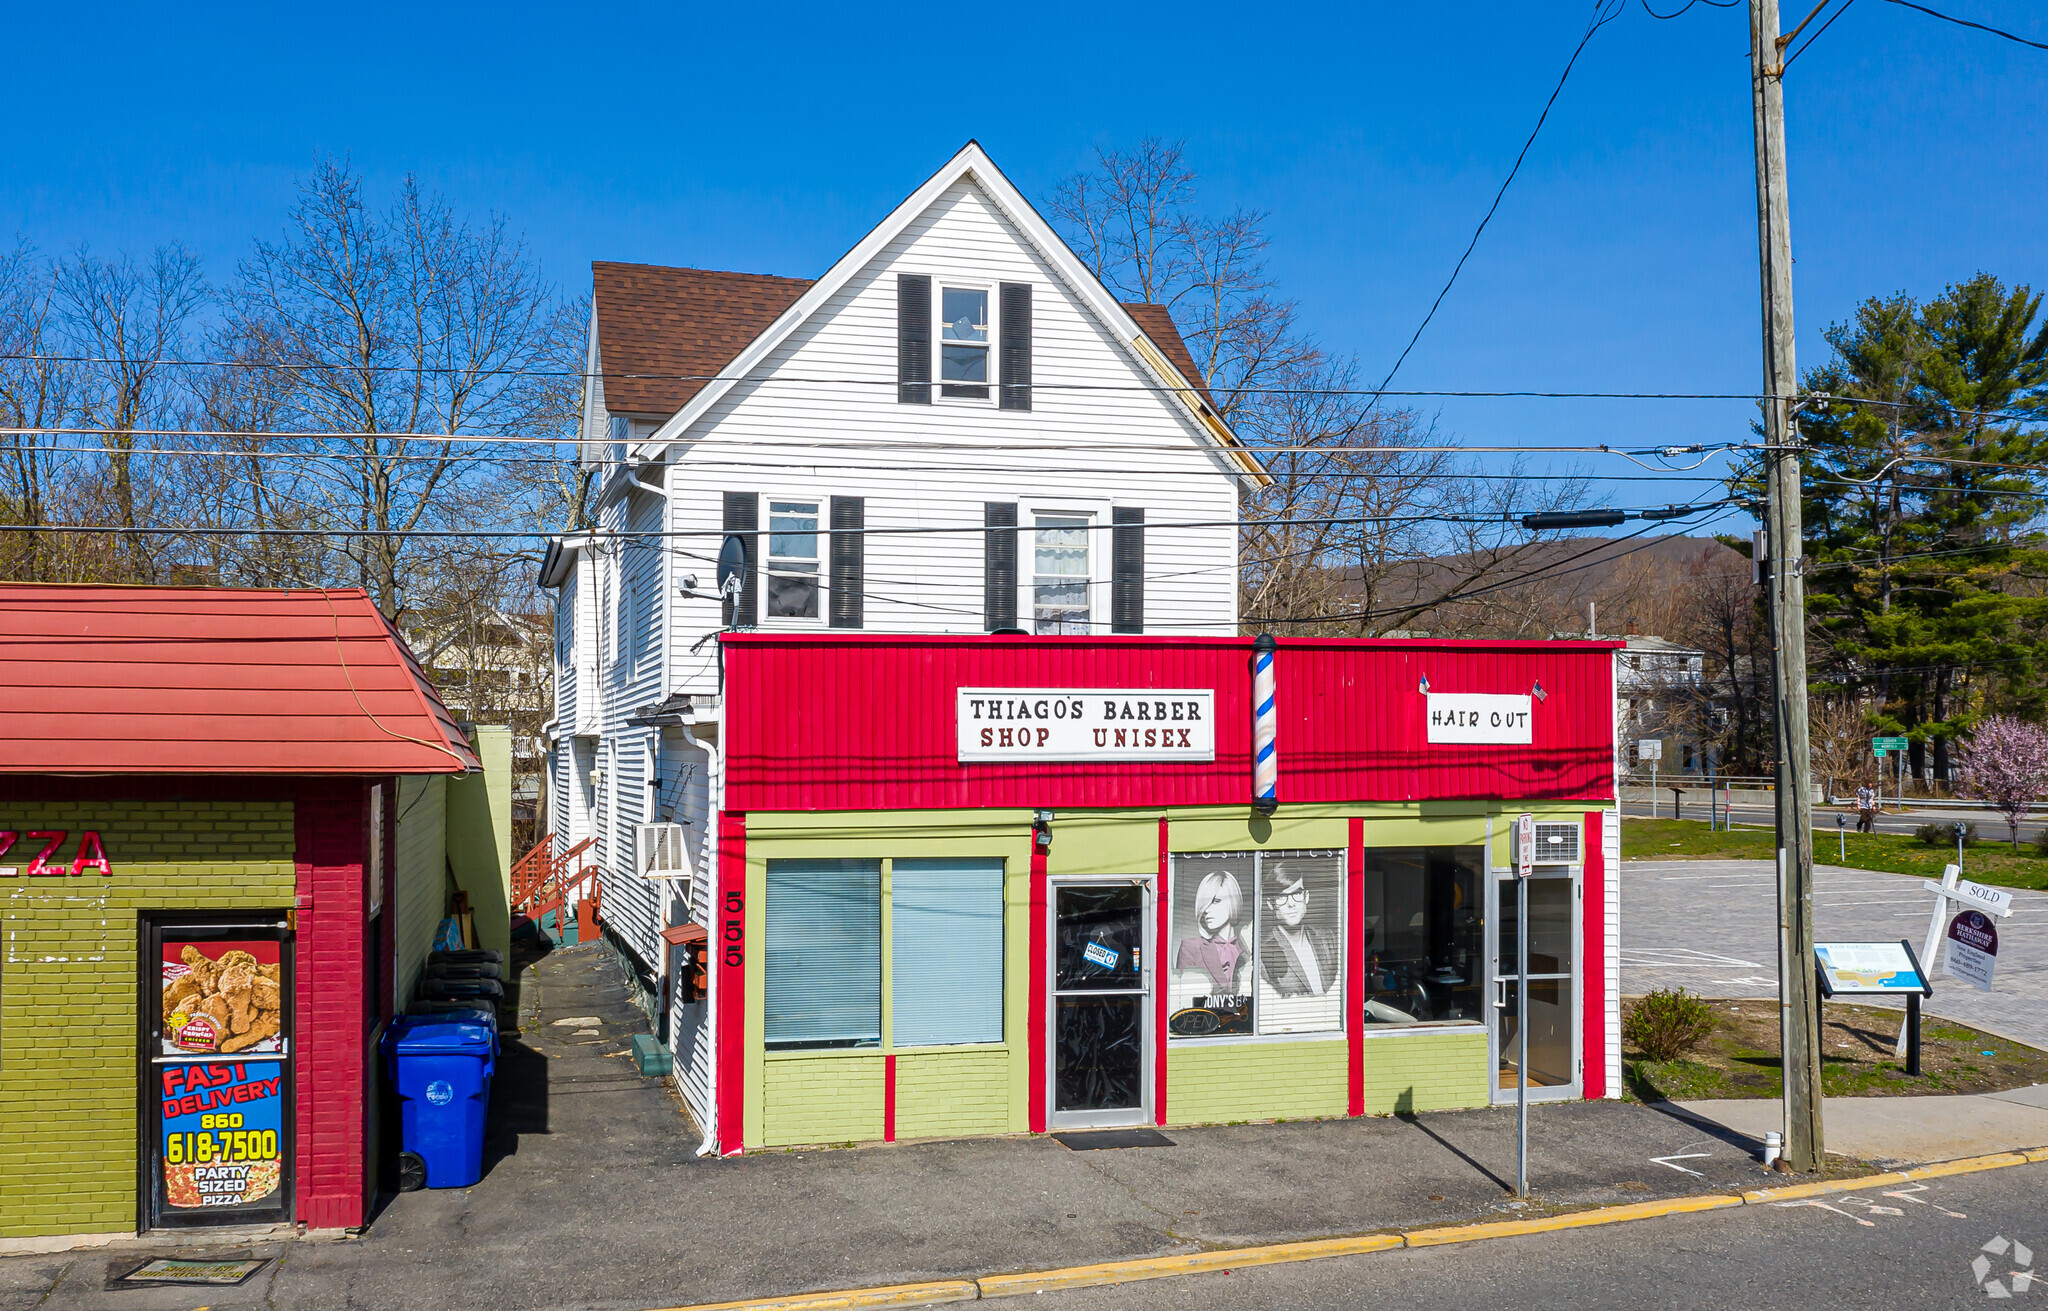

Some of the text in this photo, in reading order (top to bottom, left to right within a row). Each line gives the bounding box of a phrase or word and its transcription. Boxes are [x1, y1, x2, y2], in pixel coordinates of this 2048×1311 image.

[970, 696, 1202, 721] THIAGO'S BARBER
[1432, 709, 1528, 728] HAIR CUT
[980, 727, 1191, 748] SHOP UNISEX
[1969, 885, 2000, 903] SOLD
[724, 891, 744, 967] 555
[1956, 922, 1993, 942] BERKSHIRE
[1956, 929, 1991, 948] HATHAWAY
[1087, 944, 1107, 958] CLOSED
[1174, 1014, 1214, 1029] OPEN
[162, 1063, 246, 1097] FAST
[162, 1076, 280, 1119] DELIVERY
[201, 1113, 243, 1129] 860
[168, 1129, 277, 1163] 618-7500
[195, 1165, 250, 1180] PARTY
[198, 1180, 246, 1193] SIZED
[202, 1194, 243, 1206] PIZZA
